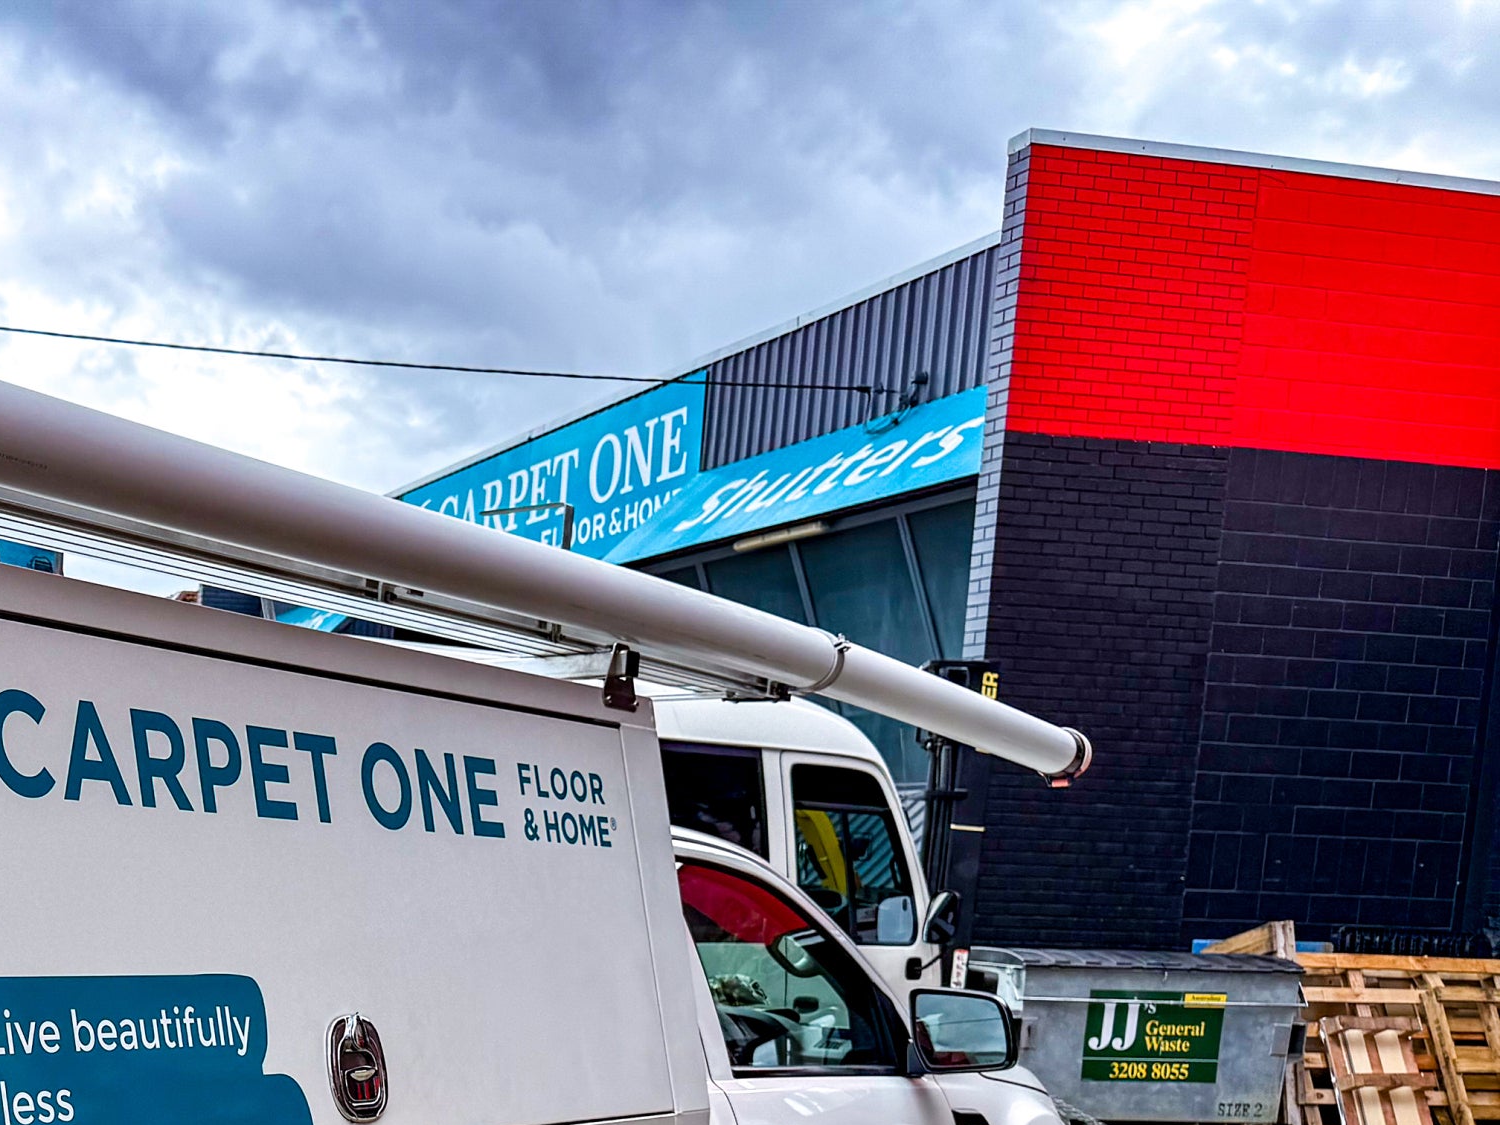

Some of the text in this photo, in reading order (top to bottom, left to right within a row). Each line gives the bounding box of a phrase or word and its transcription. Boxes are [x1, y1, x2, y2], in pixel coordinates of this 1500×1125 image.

[589, 406, 688, 504] ONE
[673, 416, 985, 532] Shutters
[361, 741, 506, 838] ONE
[517, 763, 605, 805] FLOOR
[524, 808, 540, 841] &
[70, 1006, 252, 1056] beautifully
[1145, 1020, 1206, 1037] General
[1145, 1036, 1190, 1053] Waste
[1109, 1062, 1189, 1080] 3208 8055
[1217, 1102, 1263, 1117] SIZE 2
